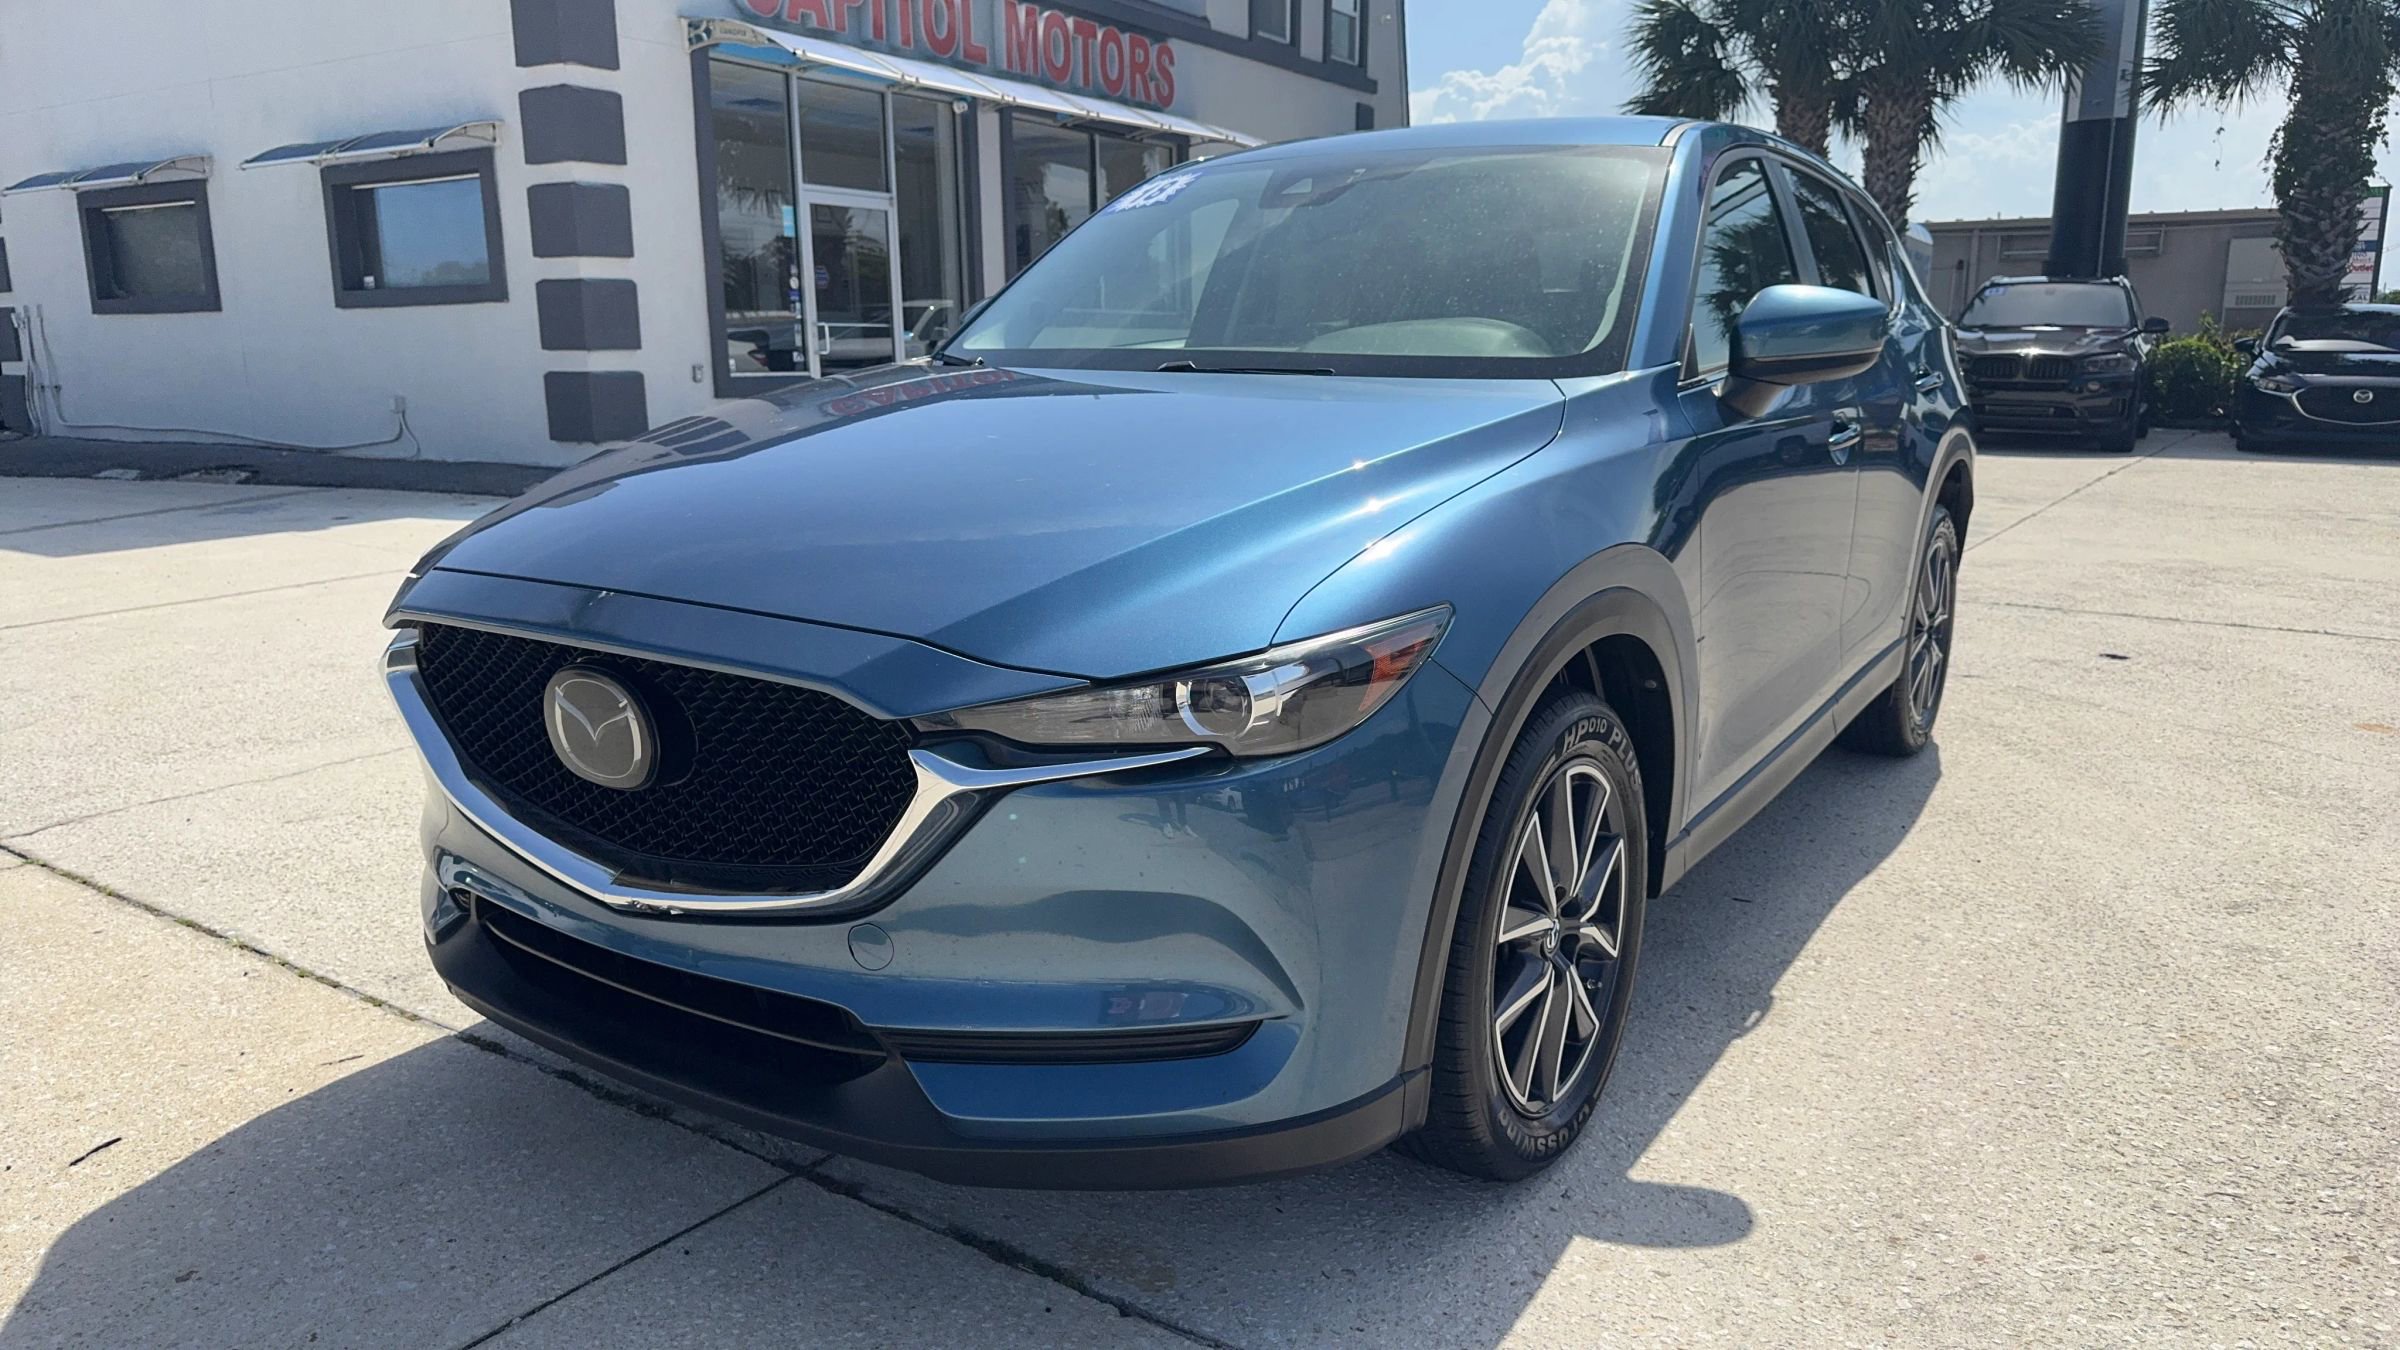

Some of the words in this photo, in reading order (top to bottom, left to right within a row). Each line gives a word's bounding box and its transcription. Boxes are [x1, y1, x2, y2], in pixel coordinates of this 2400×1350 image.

[745, 0, 988, 64] ITOL
[1004, 0, 1176, 110] MOTORS
[1562, 716, 1608, 756] HP010
[1607, 726, 1642, 791] PLUS
